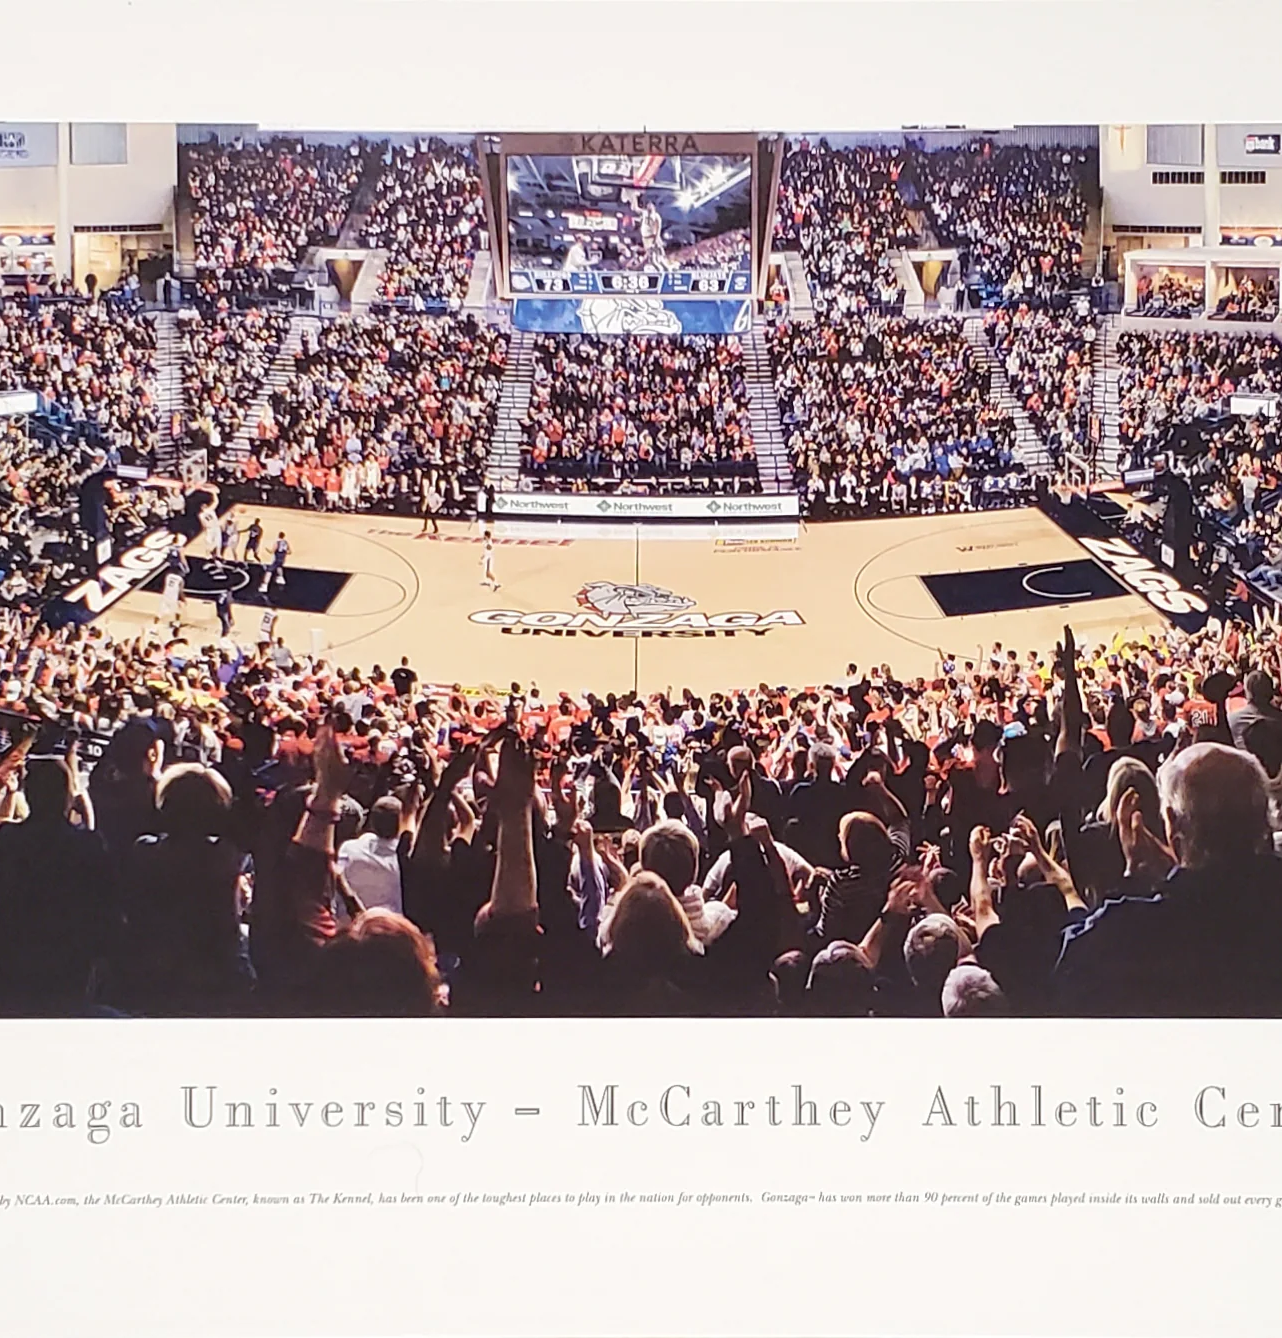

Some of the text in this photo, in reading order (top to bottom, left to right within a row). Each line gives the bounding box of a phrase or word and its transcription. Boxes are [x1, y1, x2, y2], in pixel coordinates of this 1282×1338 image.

[582, 134, 700, 153] KATERRA
[542, 278, 564, 291] 73
[697, 278, 719, 291] 63
[509, 499, 571, 511] Northwest
[613, 501, 674, 513] Northwest
[722, 501, 783, 513] Northwest
[65, 528, 187, 613] ZAGS
[1078, 537, 1210, 615] ZAGS
[468, 608, 808, 629] GONZAGA
[500, 627, 775, 638] UNIVERSITY
[180, 1085, 487, 1143] University
[576, 1084, 886, 1143] McCarthey
[921, 1084, 1159, 1128] Athletic
[0, 1192, 11, 1209] by
[15, 1192, 80, 1207] NCAA.com,
[84, 1192, 101, 1205] the
[167, 1192, 208, 1205] Athletic
[212, 1191, 249, 1206] Center,
[253, 1191, 290, 1204] known
[293, 1195, 305, 1204] as
[308, 1191, 330, 1204] The
[333, 1191, 375, 1206] Kennel,
[379, 1191, 397, 1204] has
[400, 1191, 423, 1204] been
[427, 1195, 446, 1204] one
[449, 1191, 459, 1208] of
[463, 1190, 479, 1203] the
[482, 1190, 526, 1207] toughest
[530, 1190, 562, 1207] places
[565, 1190, 575, 1203] to
[578, 1190, 601, 1207] play
[604, 1190, 616, 1203] in
[620, 1190, 636, 1203] the
[639, 1190, 675, 1203] nation
[678, 1190, 693, 1207] for
[696, 1190, 753, 1207] opponents.
[819, 1190, 837, 1203] has
[840, 1194, 863, 1203] won
[866, 1194, 891, 1203] more
[894, 1190, 920, 1203] than
[924, 1190, 938, 1203] 90
[942, 1190, 979, 1207] percent
[982, 1190, 993, 1207] of
[996, 1190, 1012, 1203] the
[1015, 1194, 1048, 1206] games
[1051, 1191, 1085, 1208] played
[1088, 1191, 1122, 1204] inside
[1125, 1191, 1138, 1204] its
[1141, 1191, 1169, 1204] walls
[1173, 1191, 1195, 1204] and
[1198, 1192, 1220, 1205] sold
[1223, 1192, 1242, 1205] out
[1244, 1196, 1272, 1208] every
